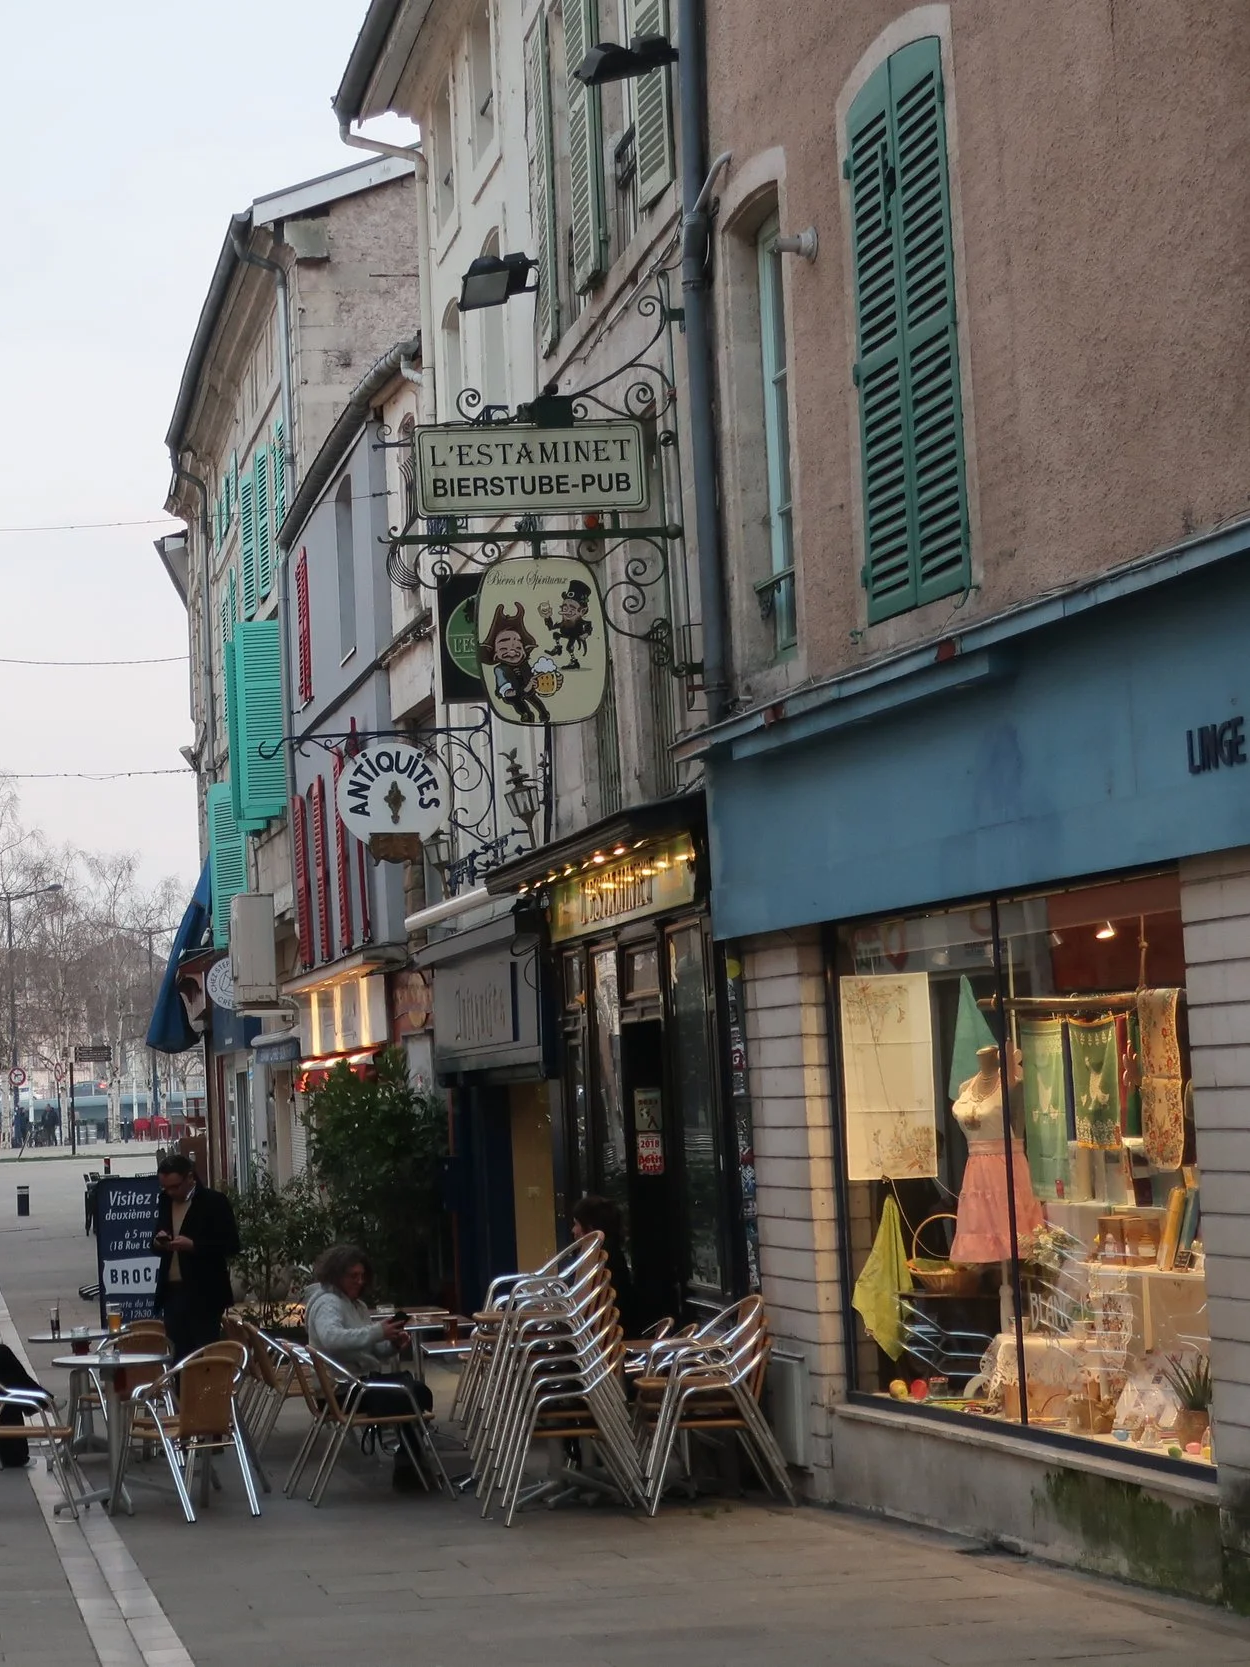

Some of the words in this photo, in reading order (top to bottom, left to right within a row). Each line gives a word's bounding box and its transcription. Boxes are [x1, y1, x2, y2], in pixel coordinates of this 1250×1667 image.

[430, 439, 631, 467] L'ESTAMINET
[433, 472, 631, 498] BIERSTUBE-PUB
[1186, 715, 1247, 774] LINGE
[210, 972, 218, 993] CHEZ
[109, 1190, 152, 1206] Visitez
[105, 1209, 151, 1221] deuxième
[132, 1229, 138, 1239] 5
[125, 1241, 140, 1250] Rue
